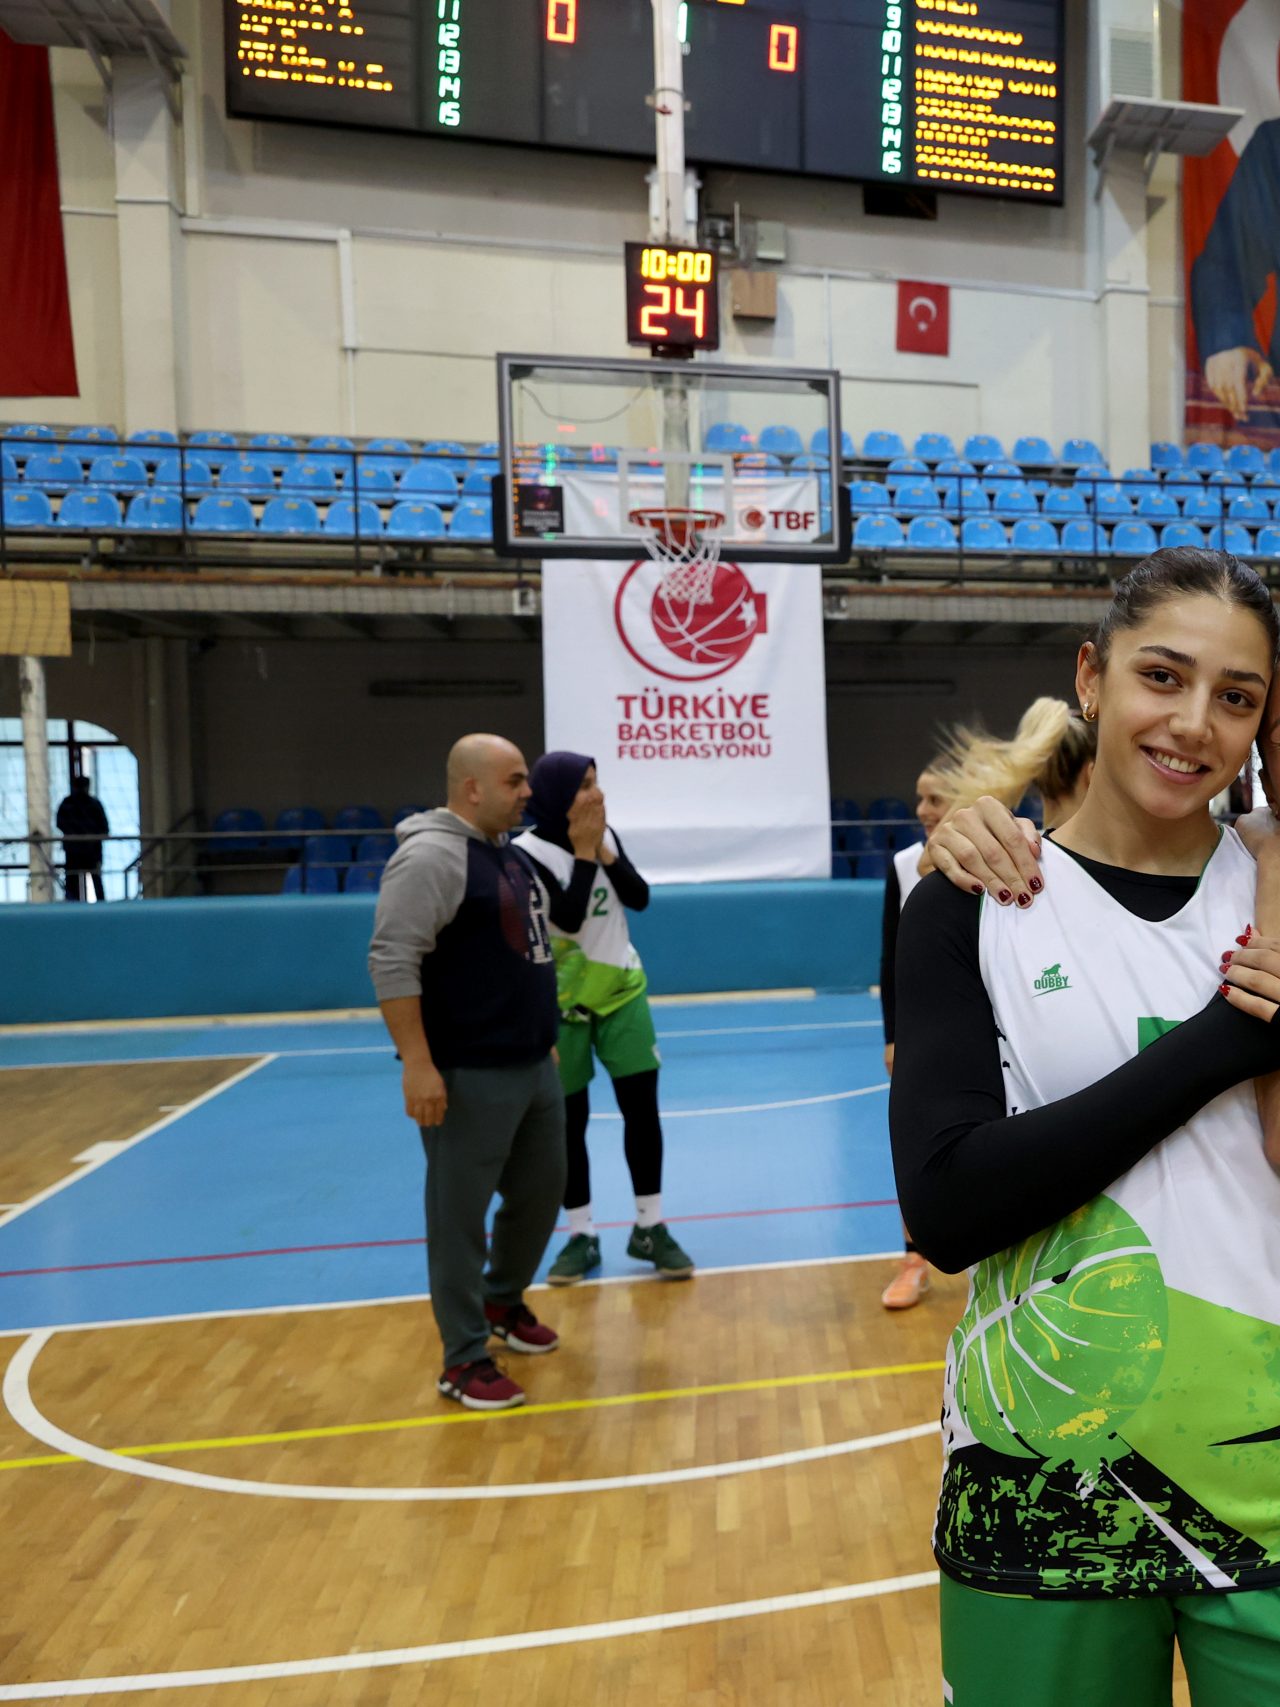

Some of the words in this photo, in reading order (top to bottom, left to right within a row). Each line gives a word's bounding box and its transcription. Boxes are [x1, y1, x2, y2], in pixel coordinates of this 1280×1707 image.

[547, 0, 576, 43] 0
[886, 5, 902, 29] 9
[438, 23, 460, 48] 12
[768, 24, 798, 72] 0
[438, 49, 460, 74] 13
[881, 54, 902, 77] 11
[438, 75, 460, 99] 14
[881, 78, 902, 101] 12
[438, 101, 460, 126] 15
[881, 102, 902, 126] 13
[641, 248, 712, 282] 10:00
[640, 284, 705, 338] 24
[768, 511, 816, 531] TBF
[616, 686, 770, 719] TÜRKİYE
[617, 723, 771, 742] BASKETBOL
[617, 743, 772, 760] FEDERASYONU
[591, 887, 609, 917] 2
[1034, 976, 1068, 989] QUBBY
